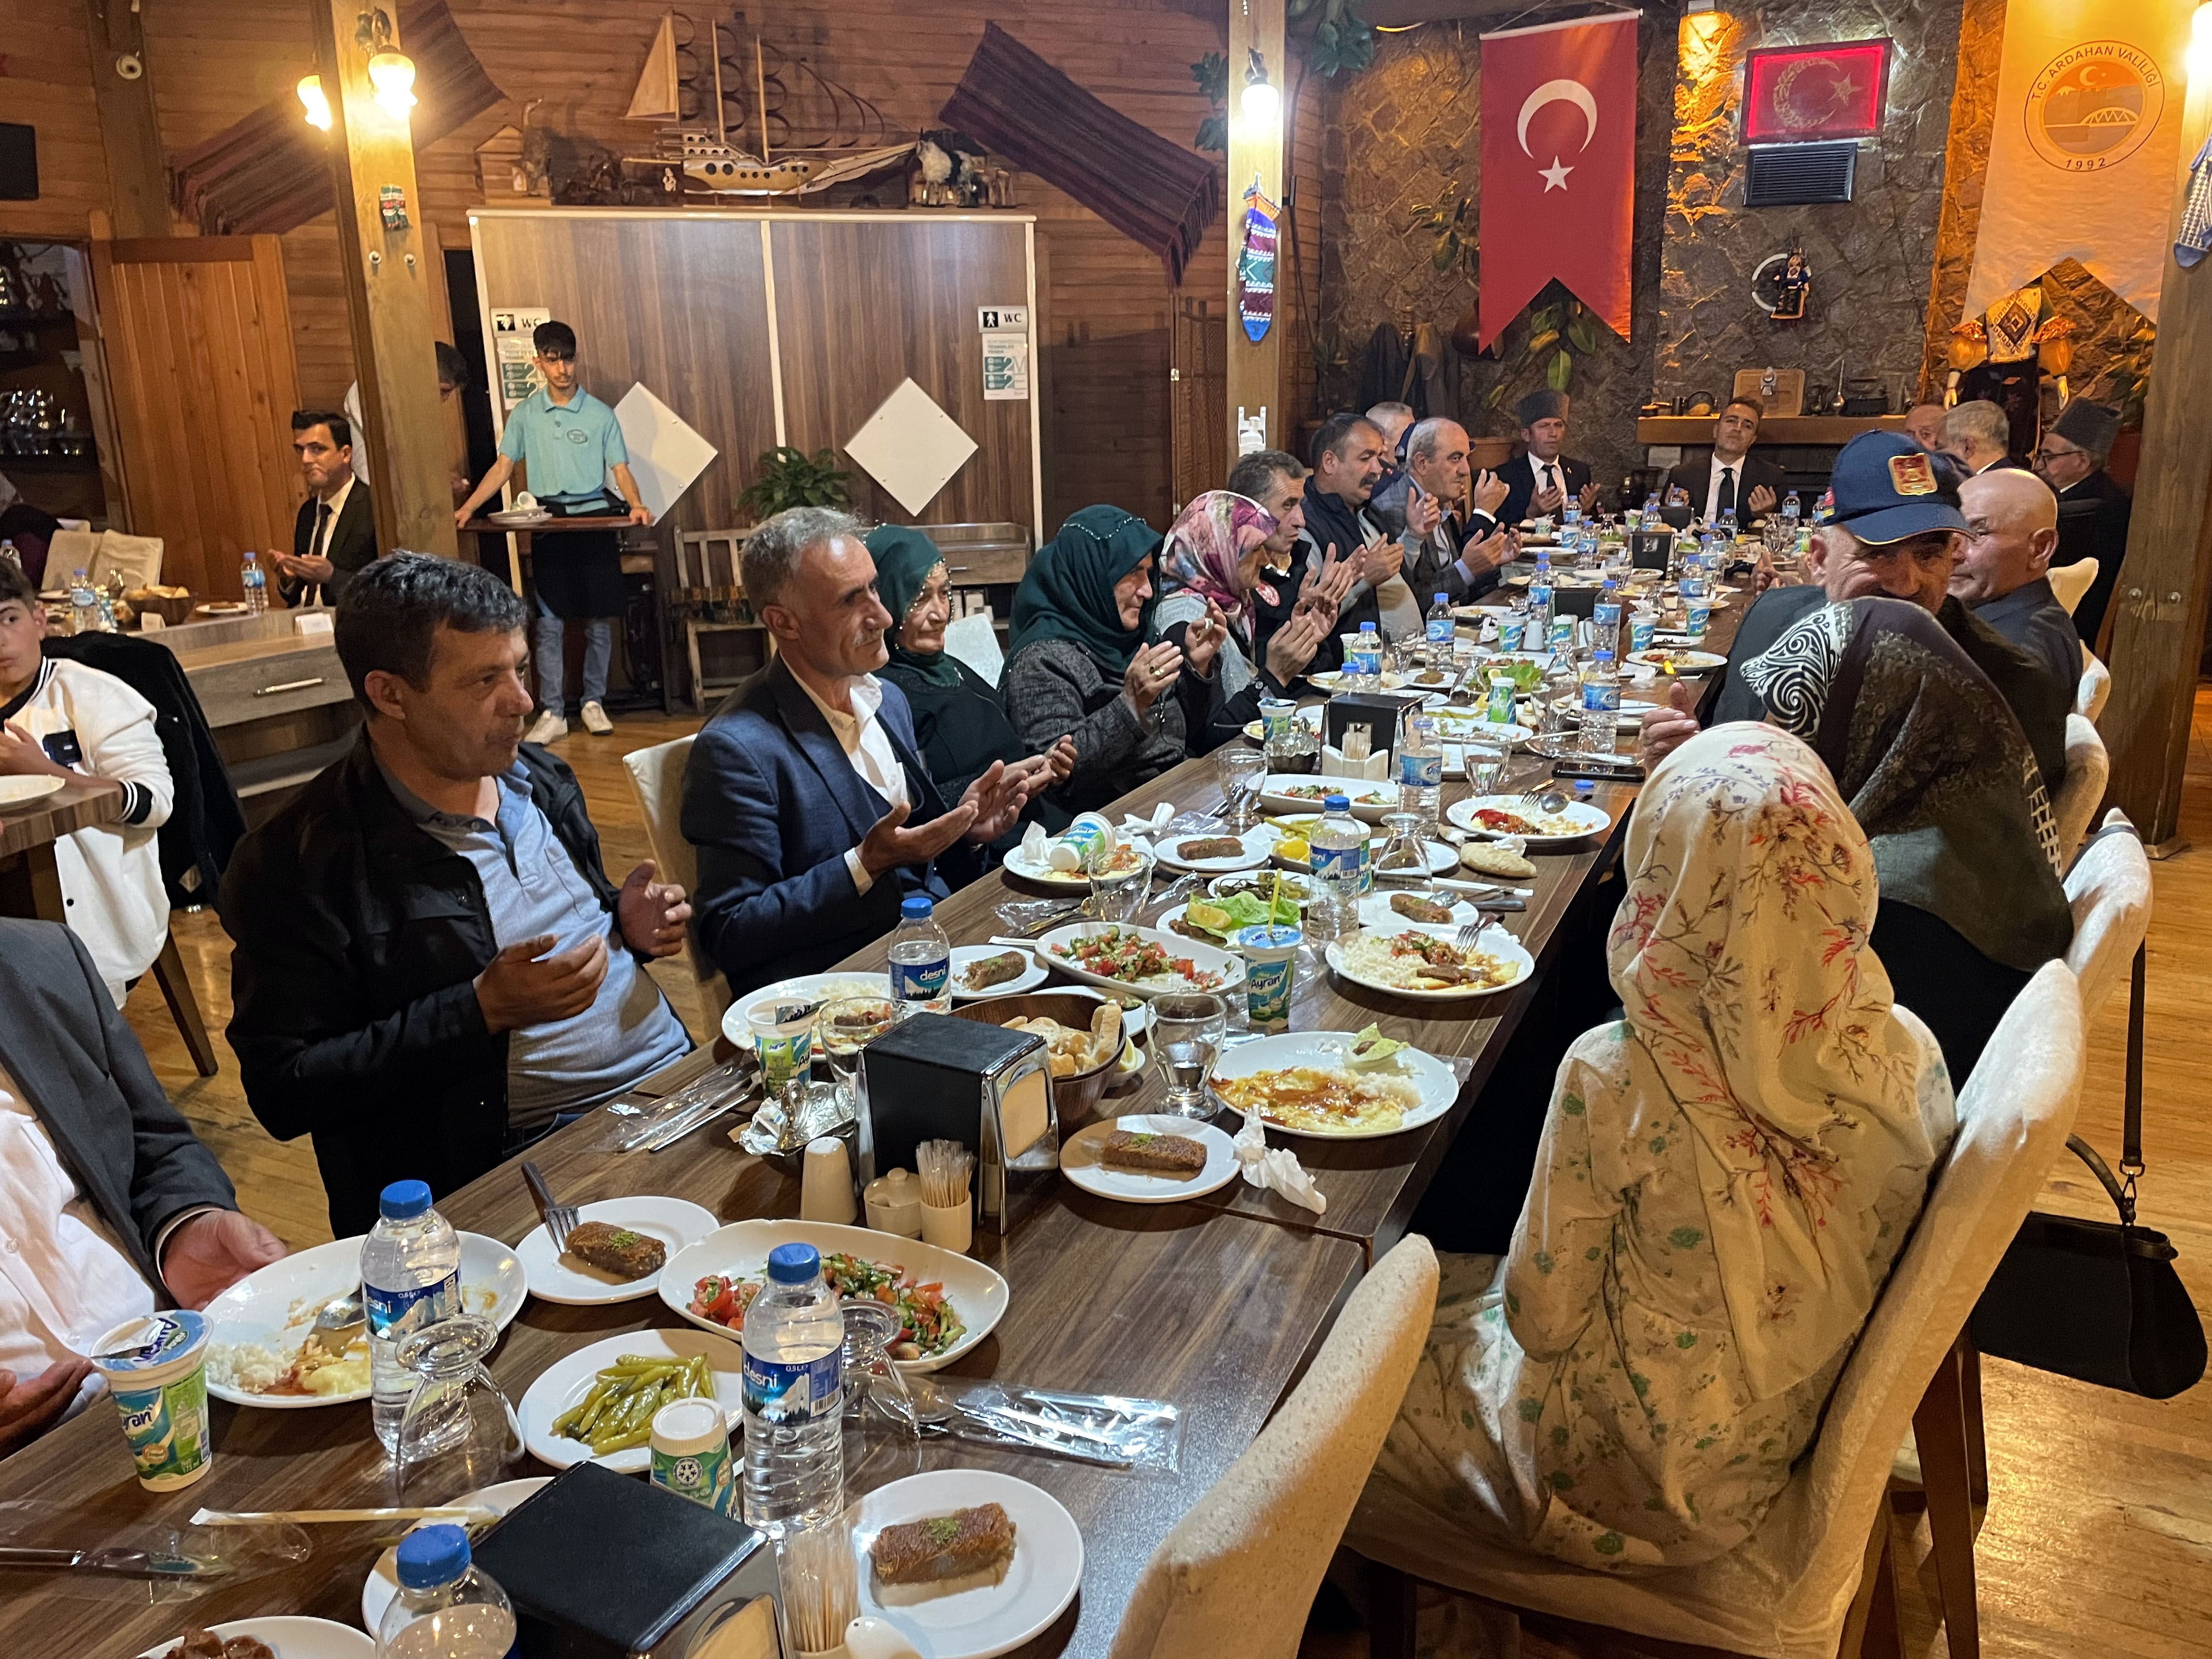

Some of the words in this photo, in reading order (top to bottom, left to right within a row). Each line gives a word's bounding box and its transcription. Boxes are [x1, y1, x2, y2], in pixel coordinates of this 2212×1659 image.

[2031, 80, 2050, 100] T.C.
[2049, 46, 2114, 77] ARDAHAN
[2066, 157, 2106, 170] 1992
[1004, 313, 1022, 323] WC
[920, 964, 946, 981] desni
[1251, 976, 1280, 990] Ayran
[743, 1362, 777, 1389] desni
